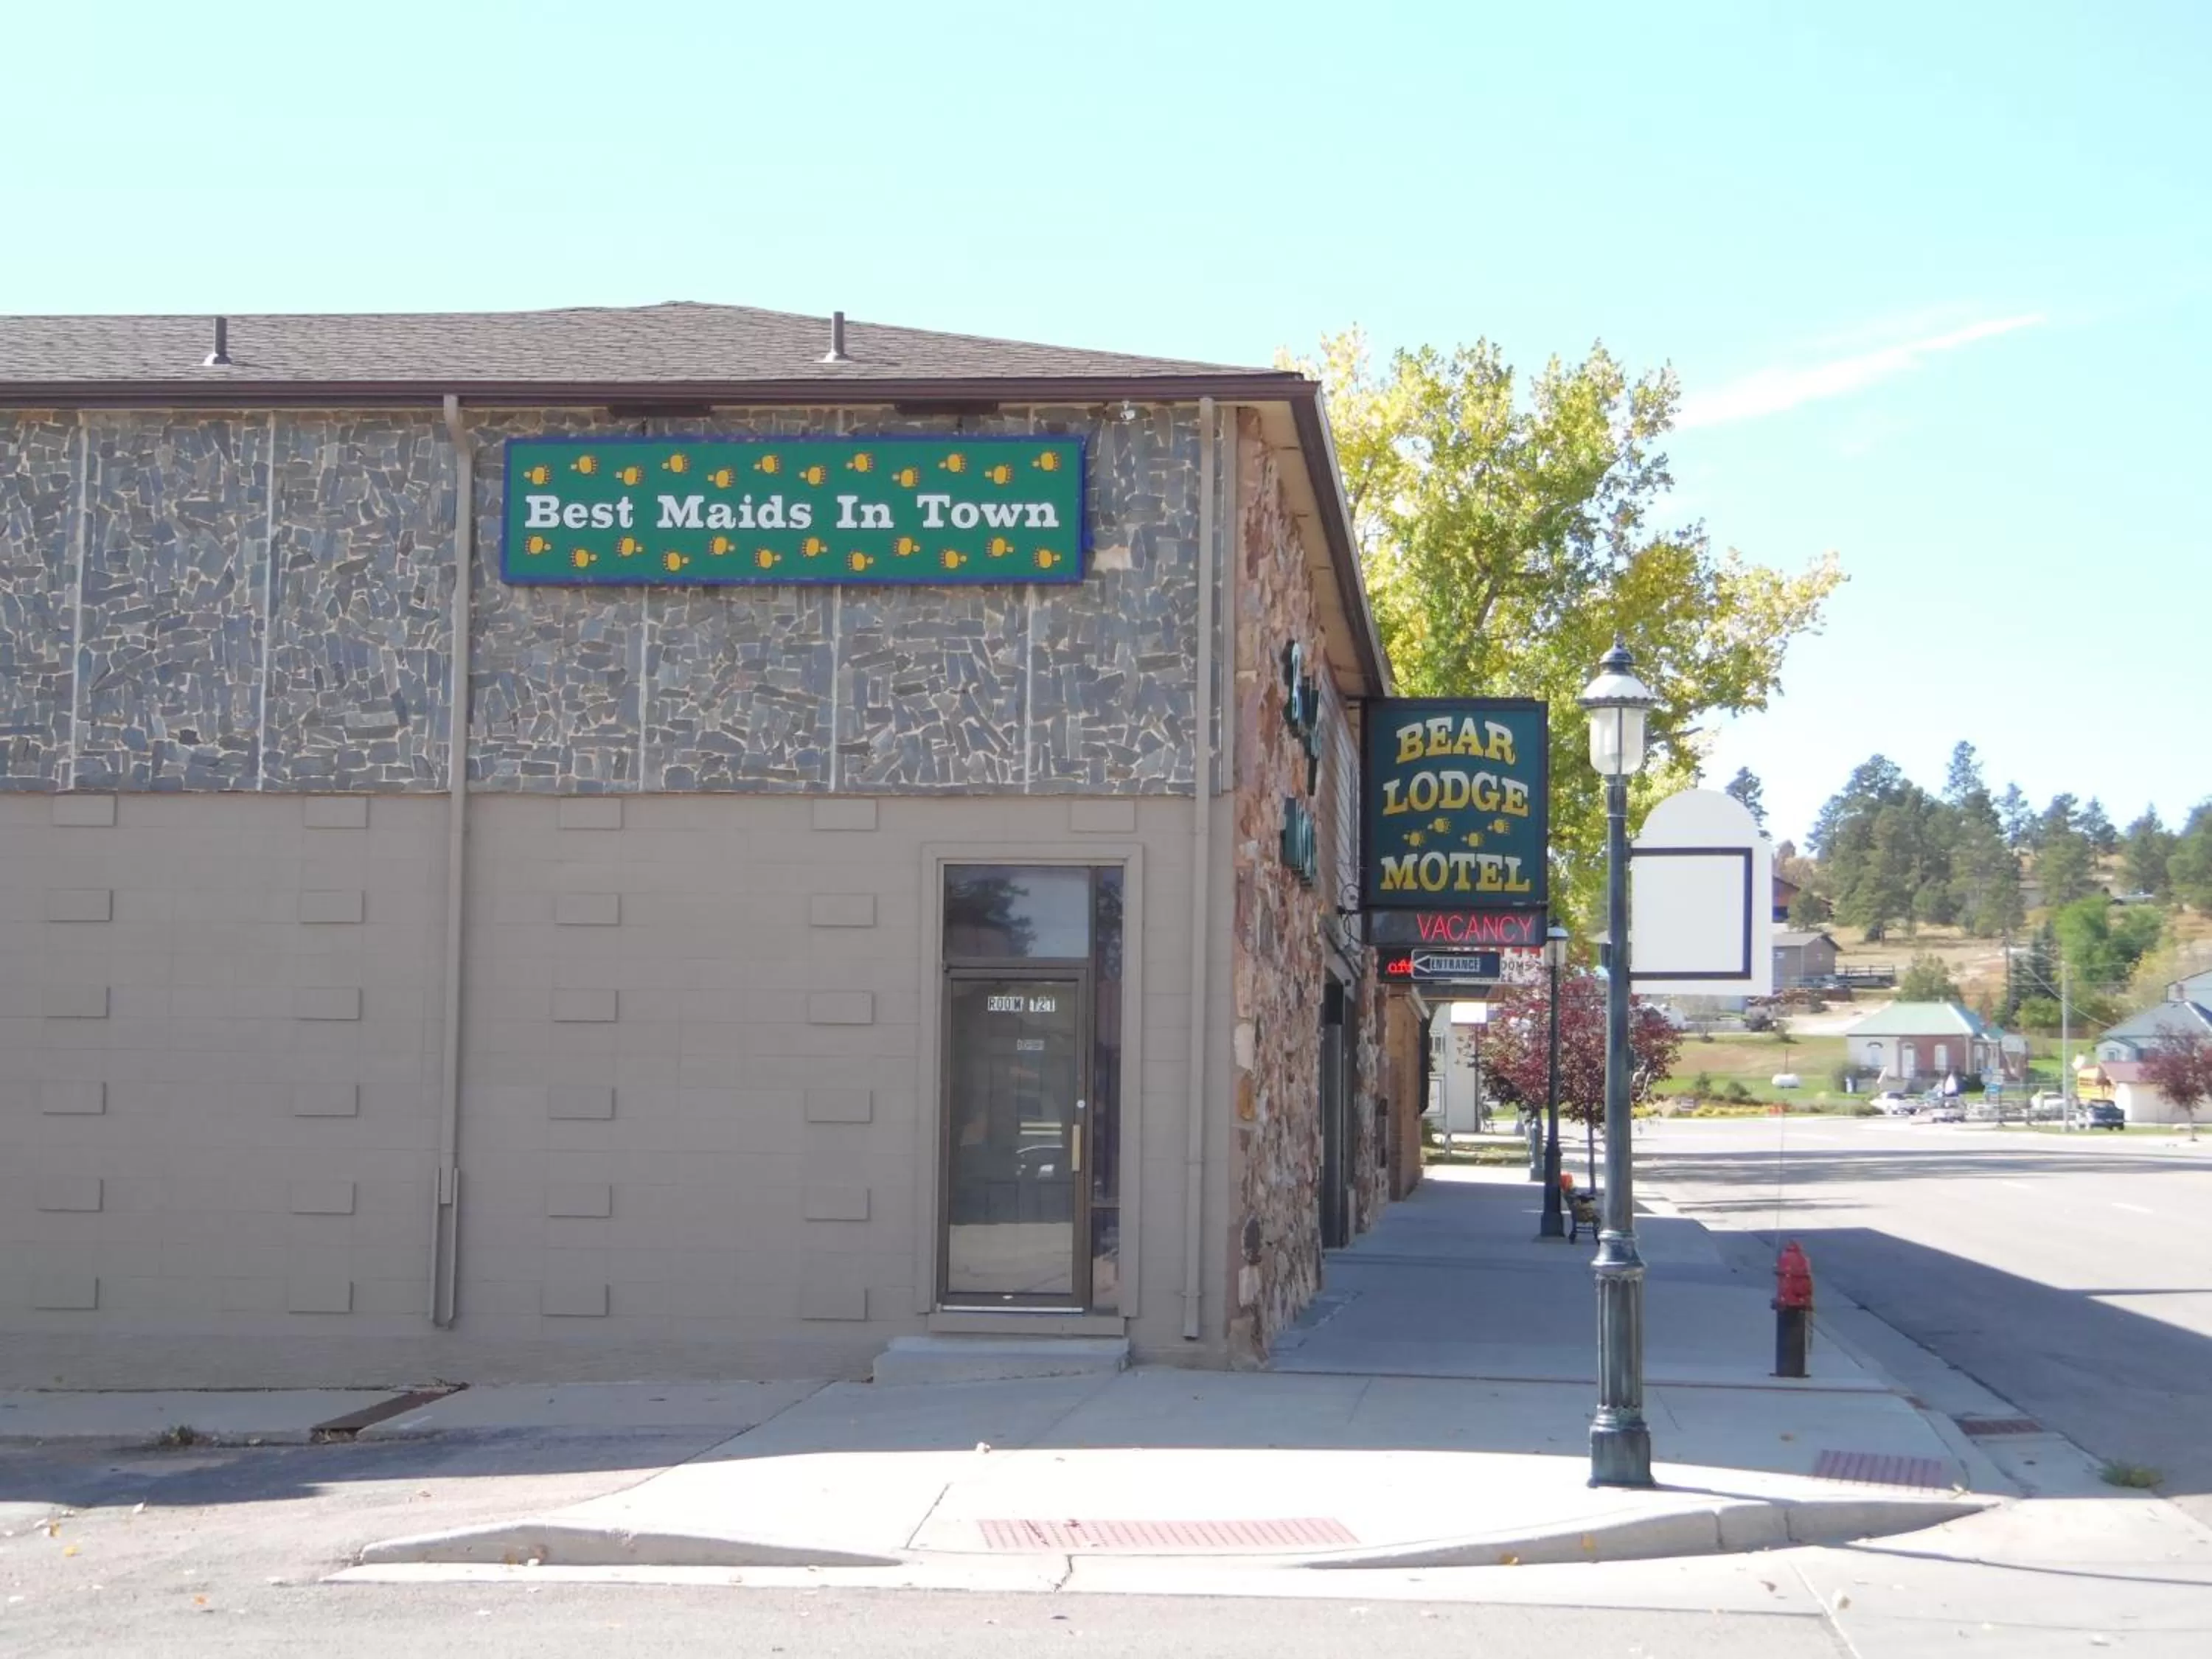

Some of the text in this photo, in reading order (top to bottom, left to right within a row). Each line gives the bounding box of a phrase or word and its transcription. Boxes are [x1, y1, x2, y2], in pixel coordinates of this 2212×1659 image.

[524, 495, 1060, 529] Best Maids In Town
[1396, 716, 1516, 765] BEAR
[1382, 771, 1528, 817] LODGE
[1380, 852, 1531, 891] MOTEL
[1416, 914, 1533, 942] VACANCY
[1430, 957, 1481, 970] ENTRANCE
[989, 997, 1022, 1011] ROOM
